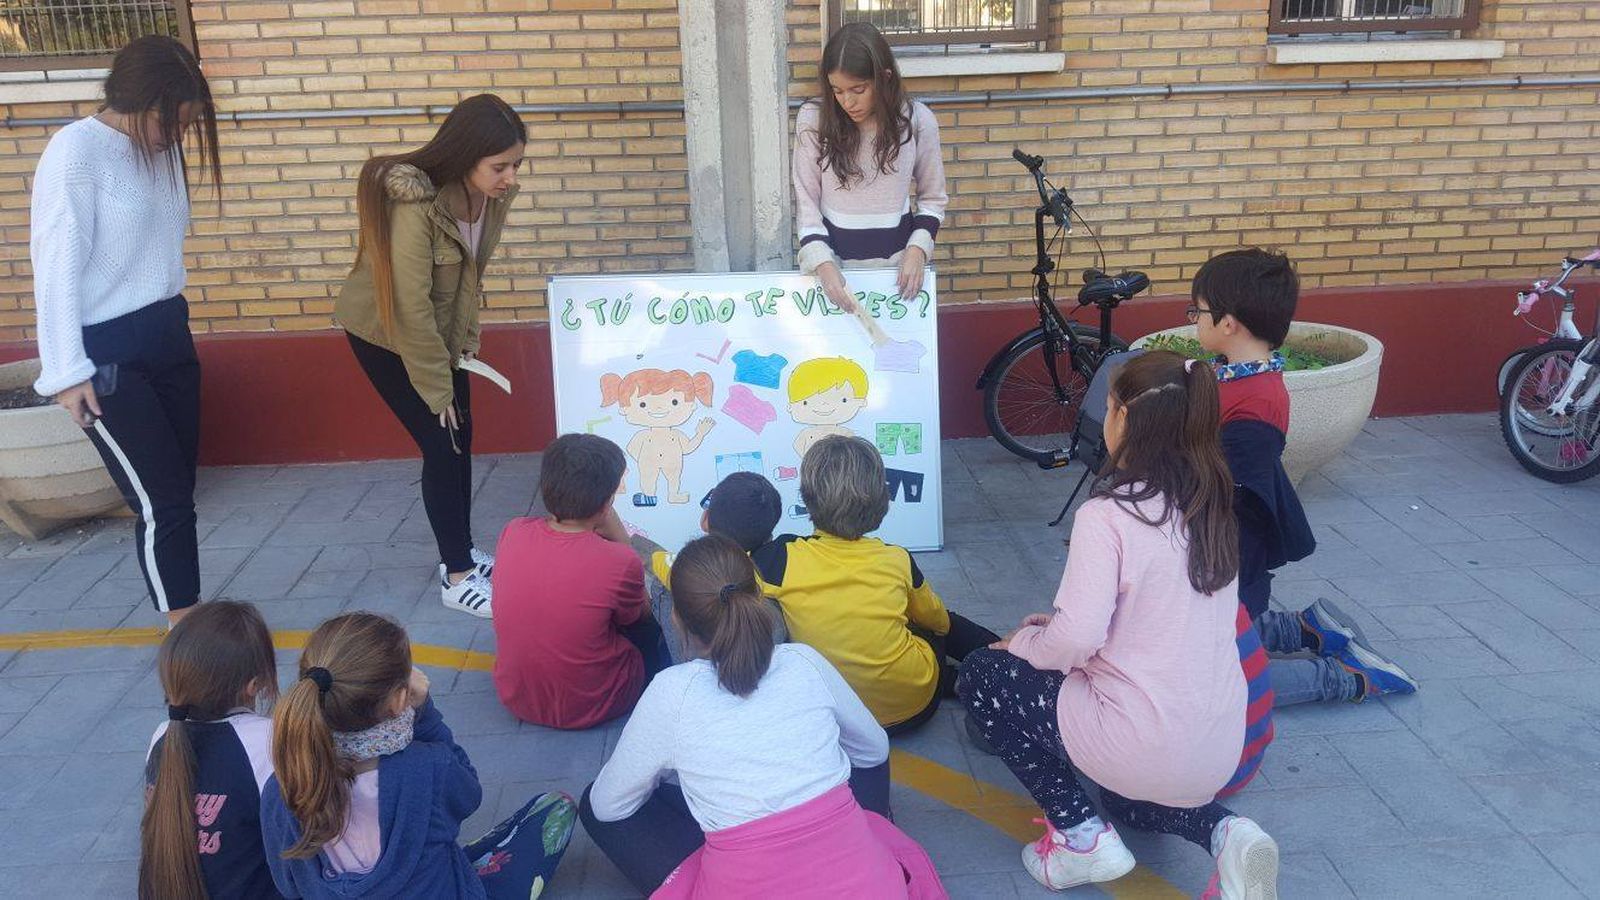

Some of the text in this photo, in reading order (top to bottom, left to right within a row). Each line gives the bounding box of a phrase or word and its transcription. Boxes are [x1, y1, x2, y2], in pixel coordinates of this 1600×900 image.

[561, 292, 633, 331] ¿TÚ
[647, 291, 735, 325] CÓMO
[745, 287, 785, 317] TE
